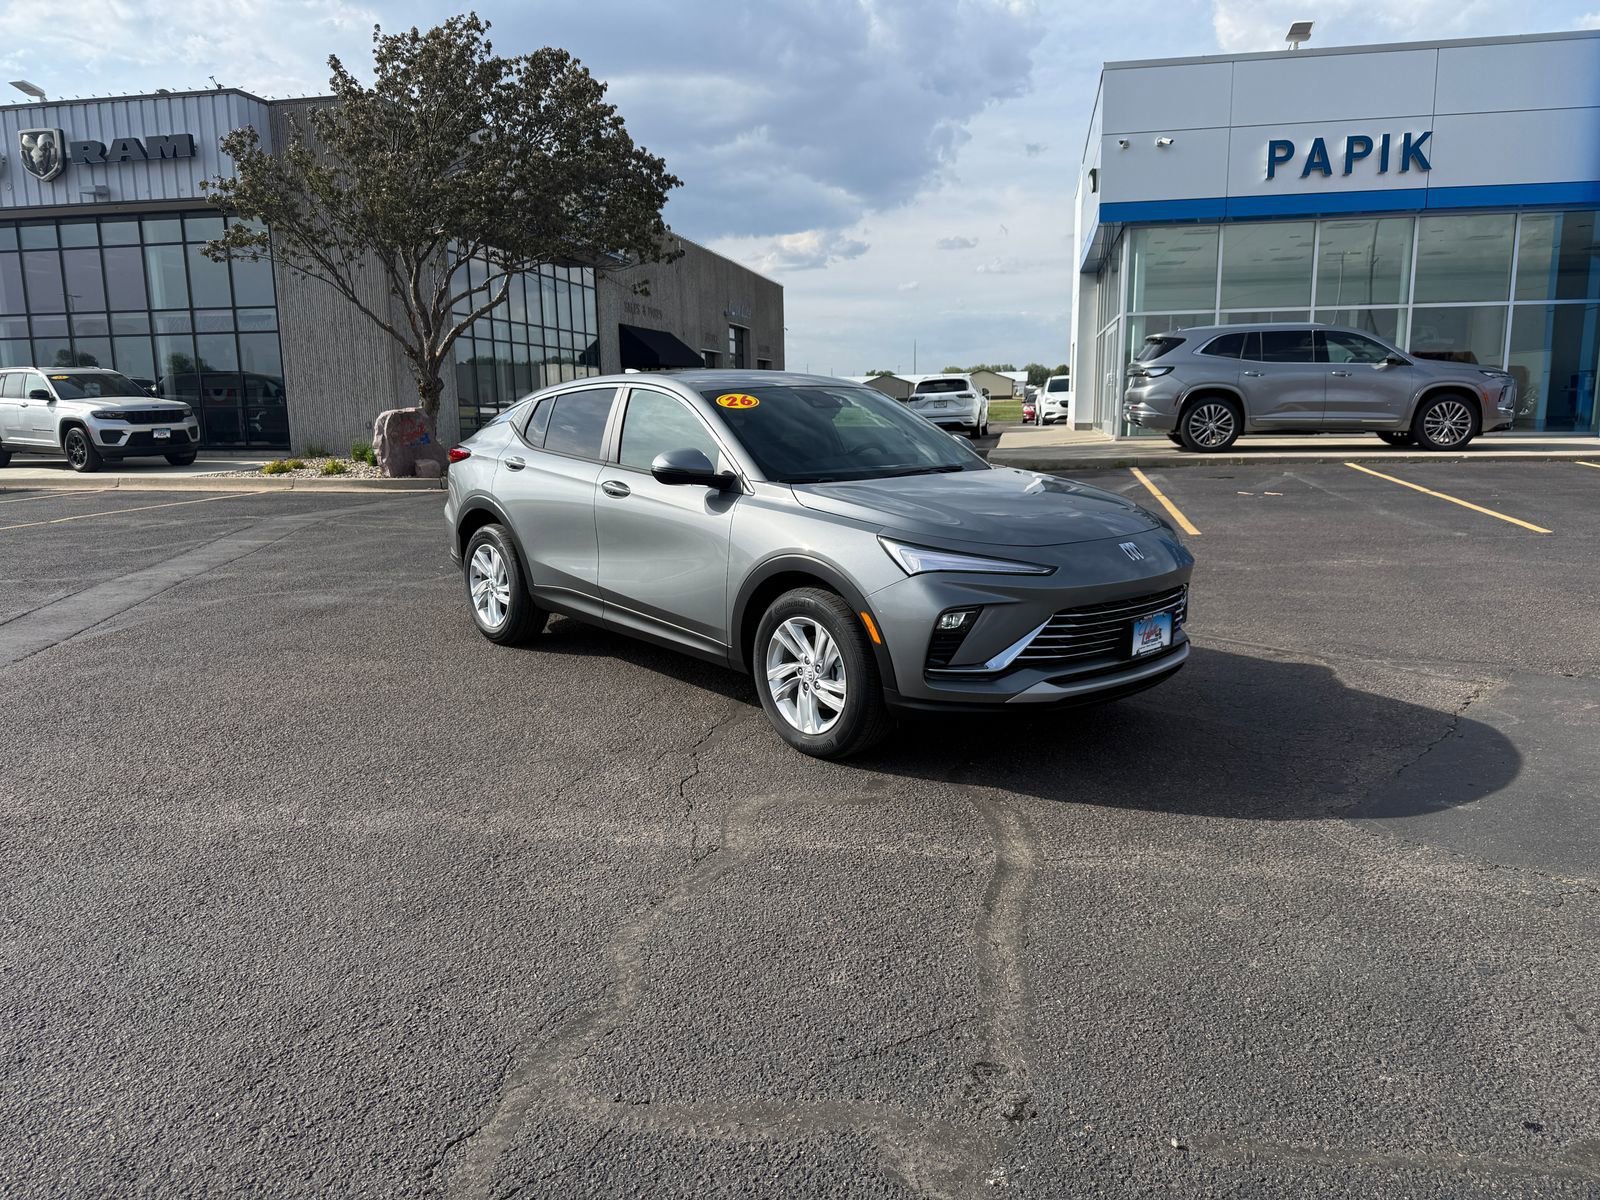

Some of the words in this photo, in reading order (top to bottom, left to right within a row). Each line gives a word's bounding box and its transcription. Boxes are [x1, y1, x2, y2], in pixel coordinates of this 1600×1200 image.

[70, 133, 196, 165] RAM
[1265, 131, 1434, 180] PAPIK
[725, 395, 753, 407] 26
